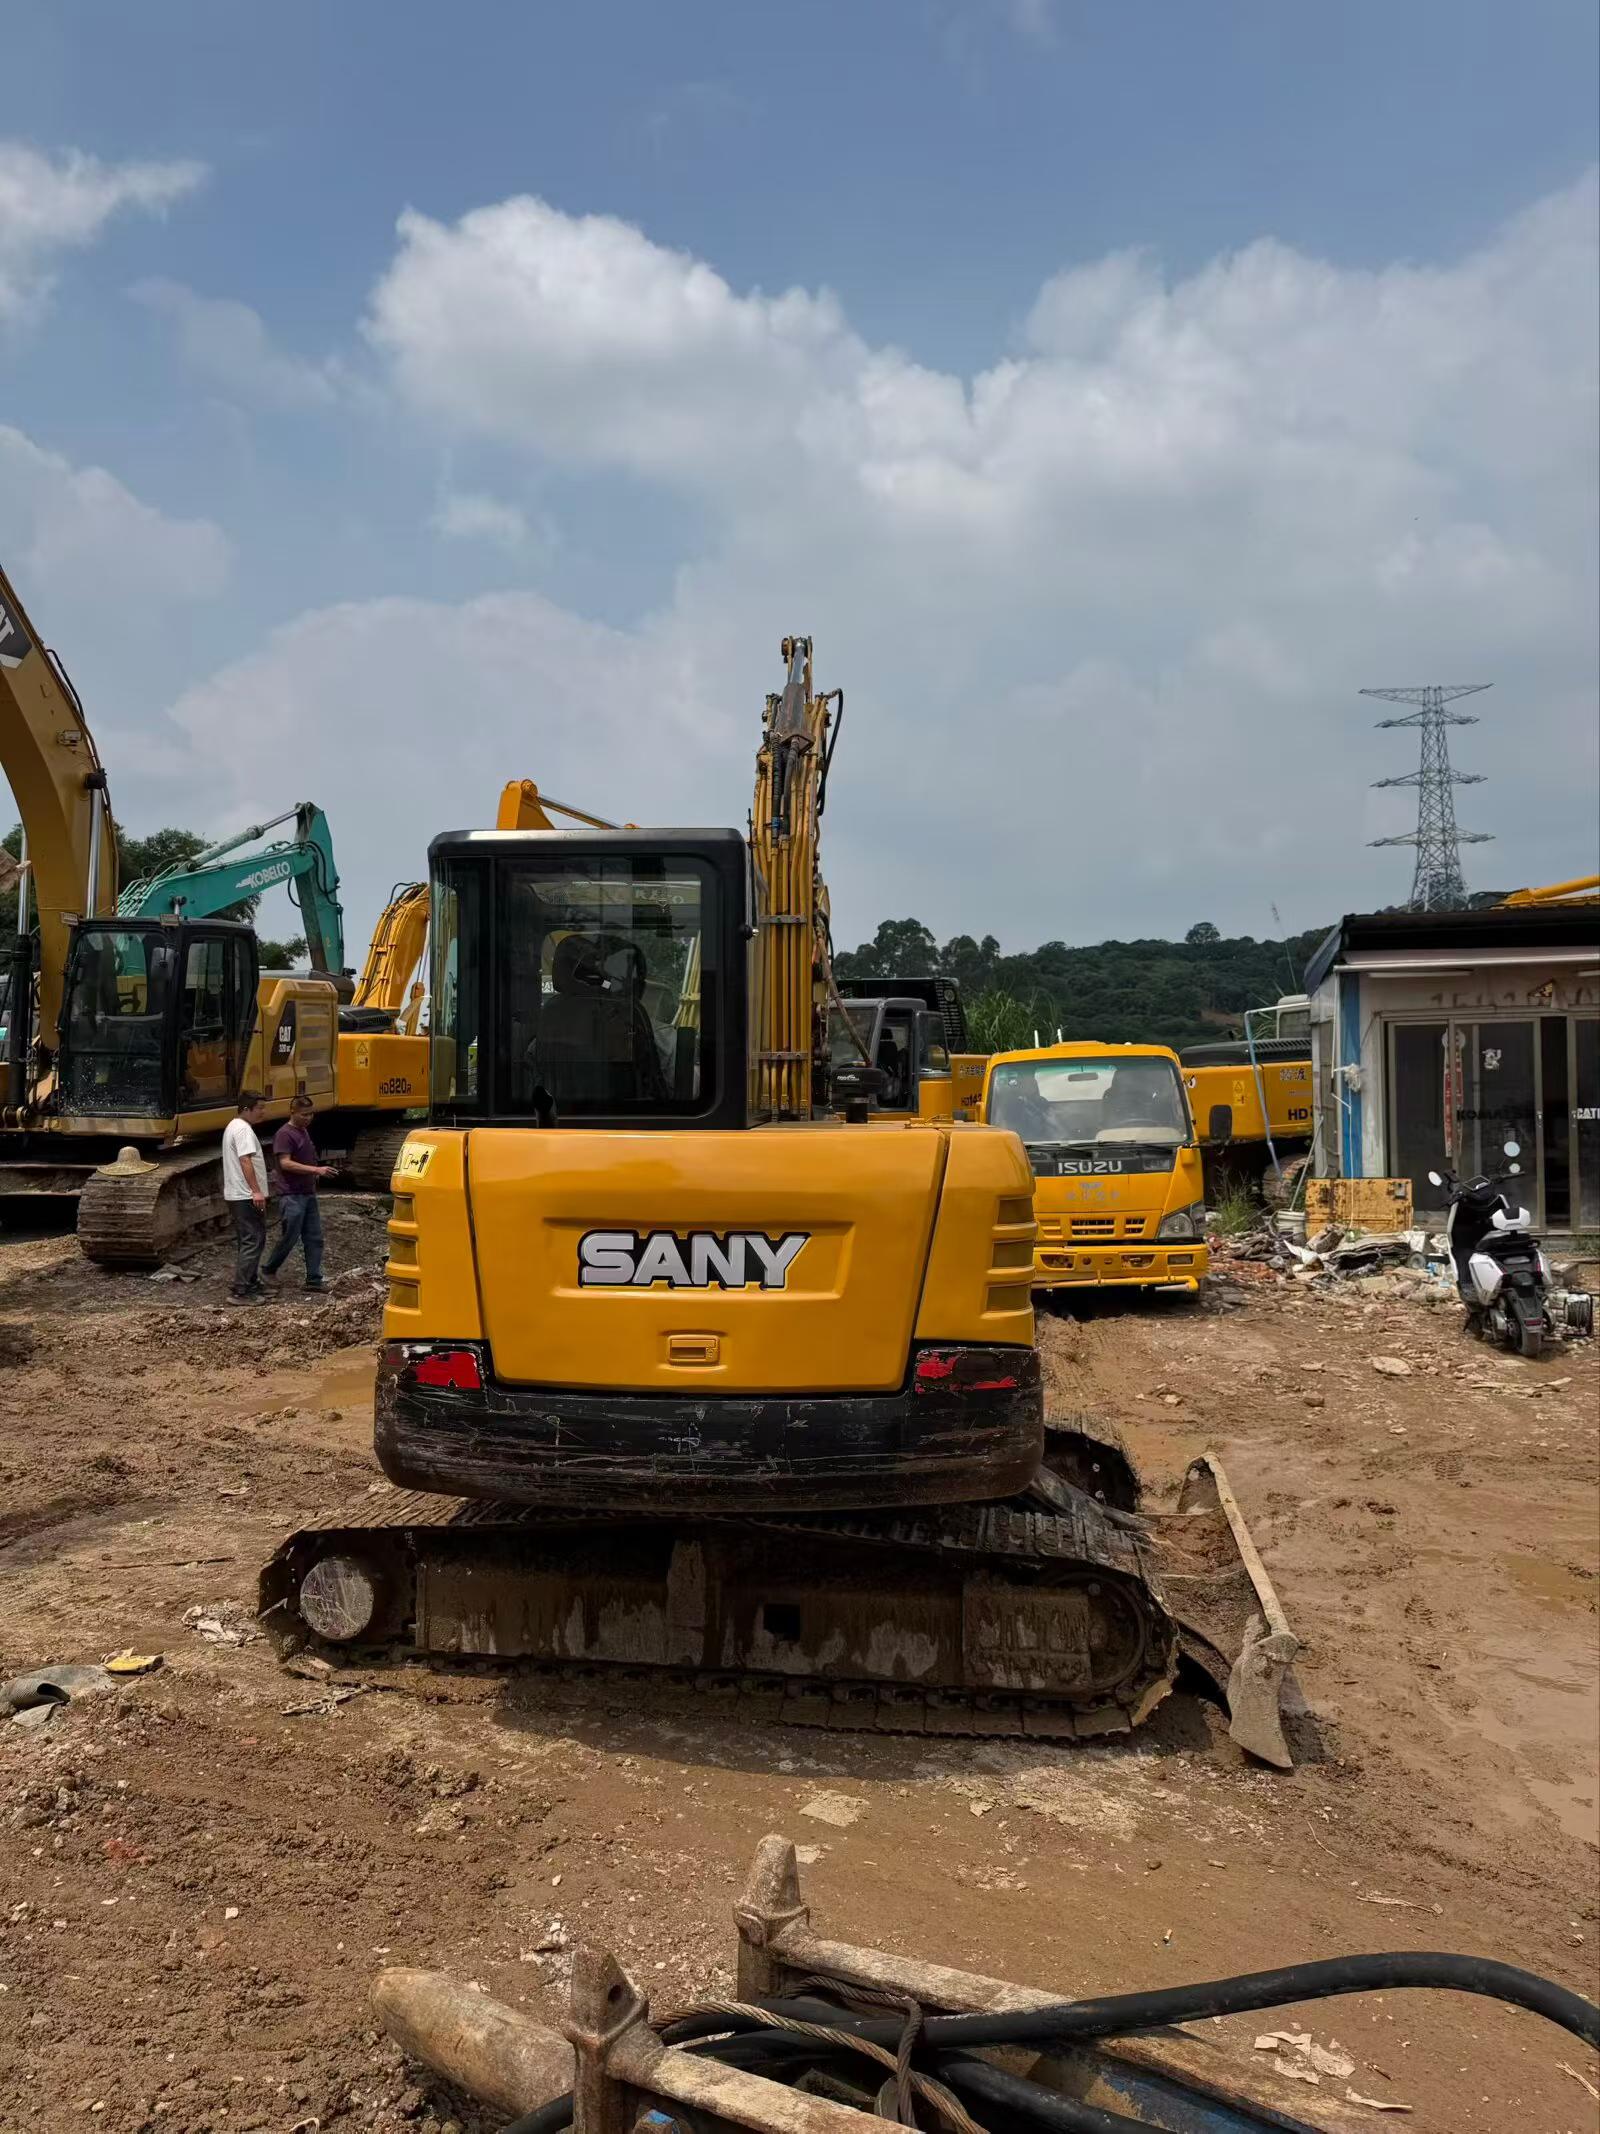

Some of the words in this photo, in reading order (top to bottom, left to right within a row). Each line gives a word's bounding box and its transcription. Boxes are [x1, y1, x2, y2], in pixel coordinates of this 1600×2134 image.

[279, 1026, 291, 1042] CAT
[1058, 1160, 1122, 1174] ISUZU
[578, 1230, 811, 1290] SANY
